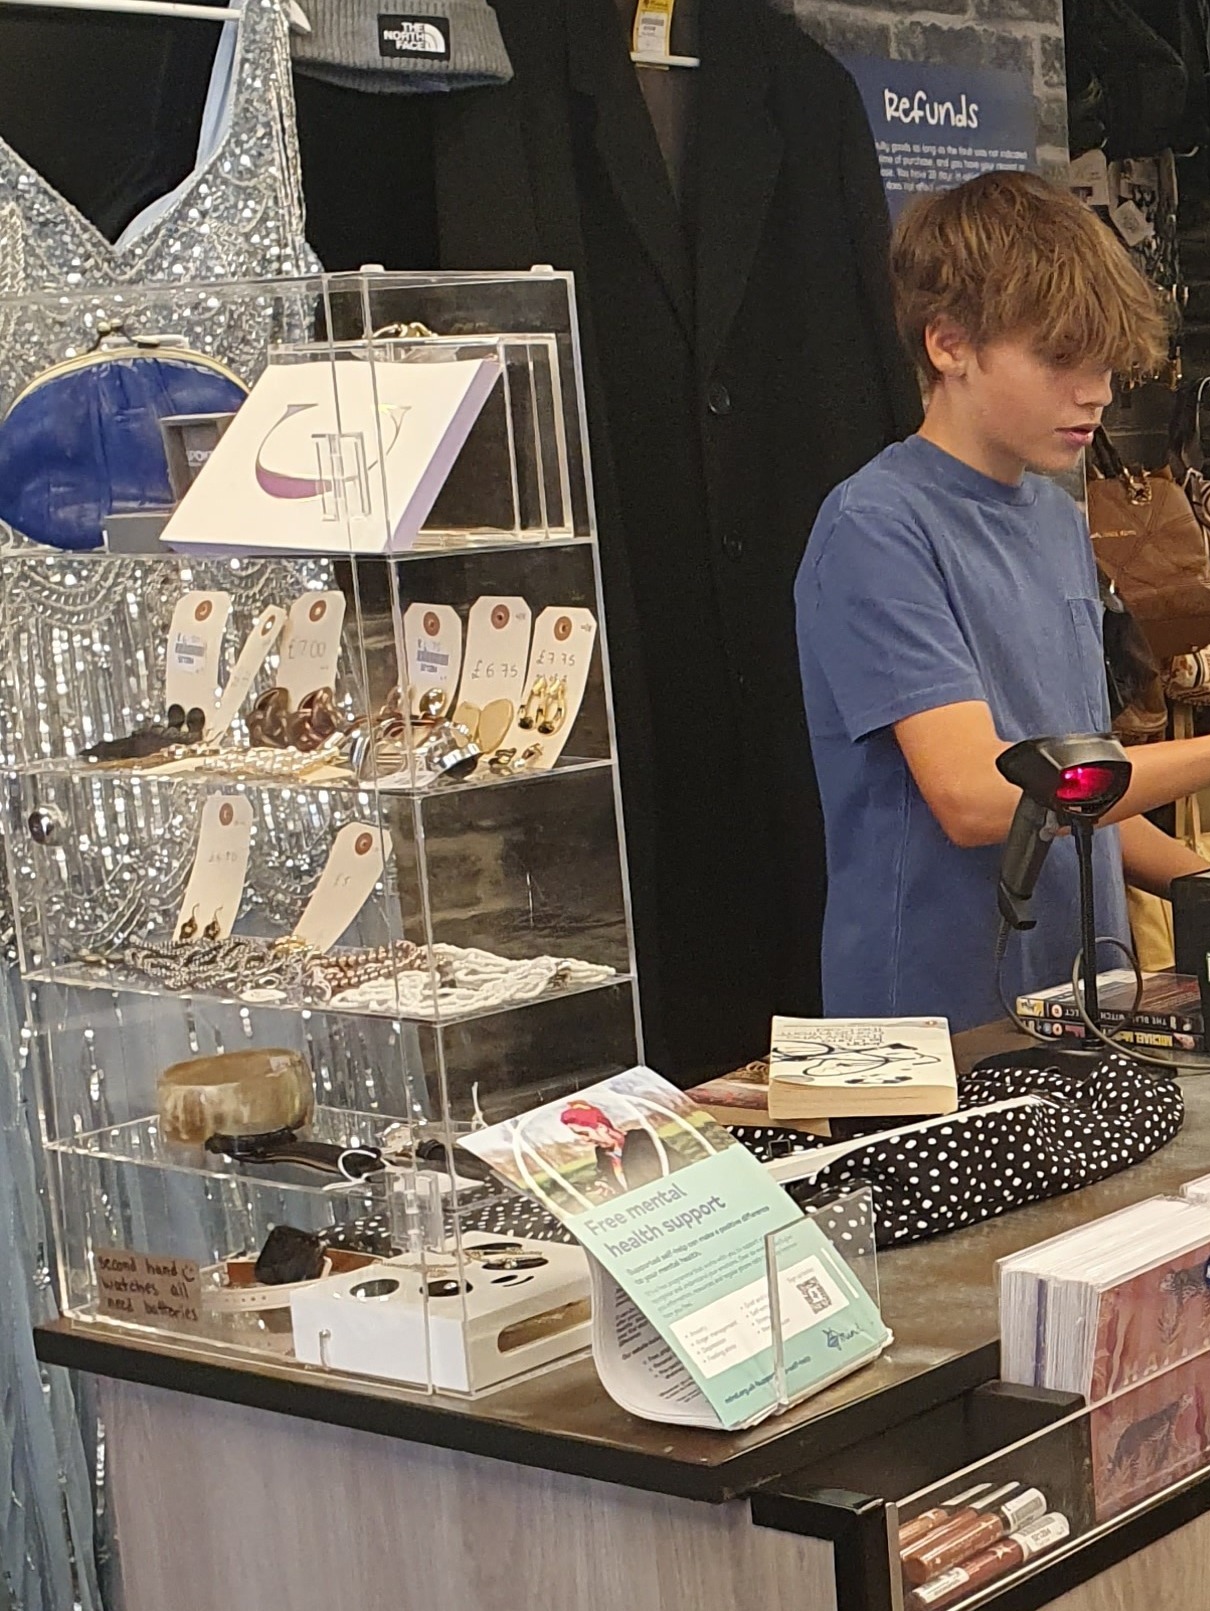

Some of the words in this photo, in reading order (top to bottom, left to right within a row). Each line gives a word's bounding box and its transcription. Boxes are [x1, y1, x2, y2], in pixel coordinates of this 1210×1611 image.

[401, 22, 424, 32] THE
[384, 30, 424, 42] NORTH
[396, 40, 425, 52] FACE
[884, 88, 978, 128] Refunds
[1100, 1012, 1126, 1022] WITCH
[1152, 1016, 1167, 1026] THE
[1134, 1032, 1174, 1047] MICHAEL
[584, 1212, 628, 1236] Free
[626, 1182, 688, 1220] mental
[604, 1224, 664, 1258] health
[662, 1195, 726, 1234] support
[98, 1255, 136, 1272] second
[144, 1258, 178, 1276] hand
[100, 1277, 160, 1296] watches
[170, 1282, 189, 1300] all
